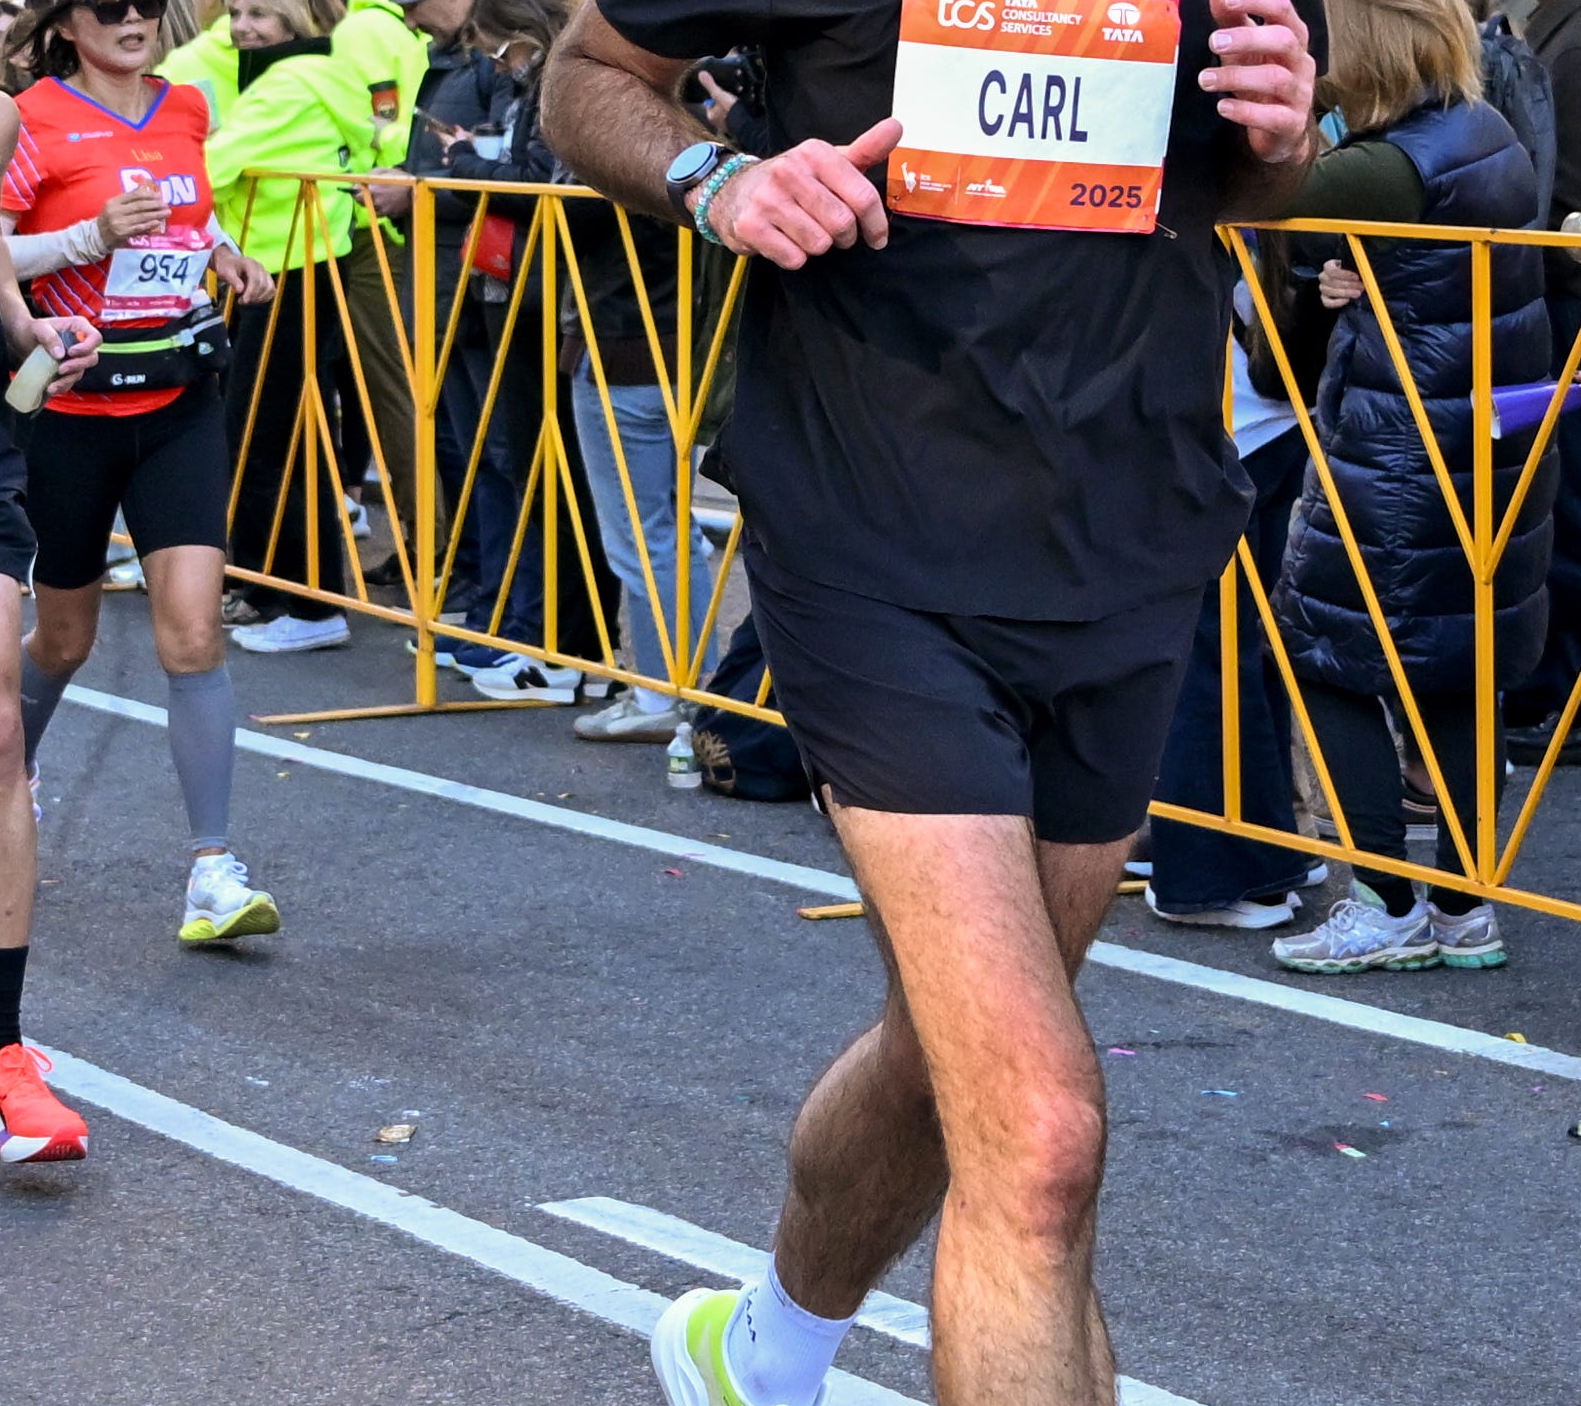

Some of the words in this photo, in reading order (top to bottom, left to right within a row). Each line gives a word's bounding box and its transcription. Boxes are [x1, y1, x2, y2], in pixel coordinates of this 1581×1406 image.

[1001, 8, 1083, 25] CONSULTANCY
[1000, 21, 1052, 36] SERVICES
[1102, 28, 1144, 43] TATA
[978, 69, 1089, 143] CARL
[1069, 182, 1143, 209] 2025
